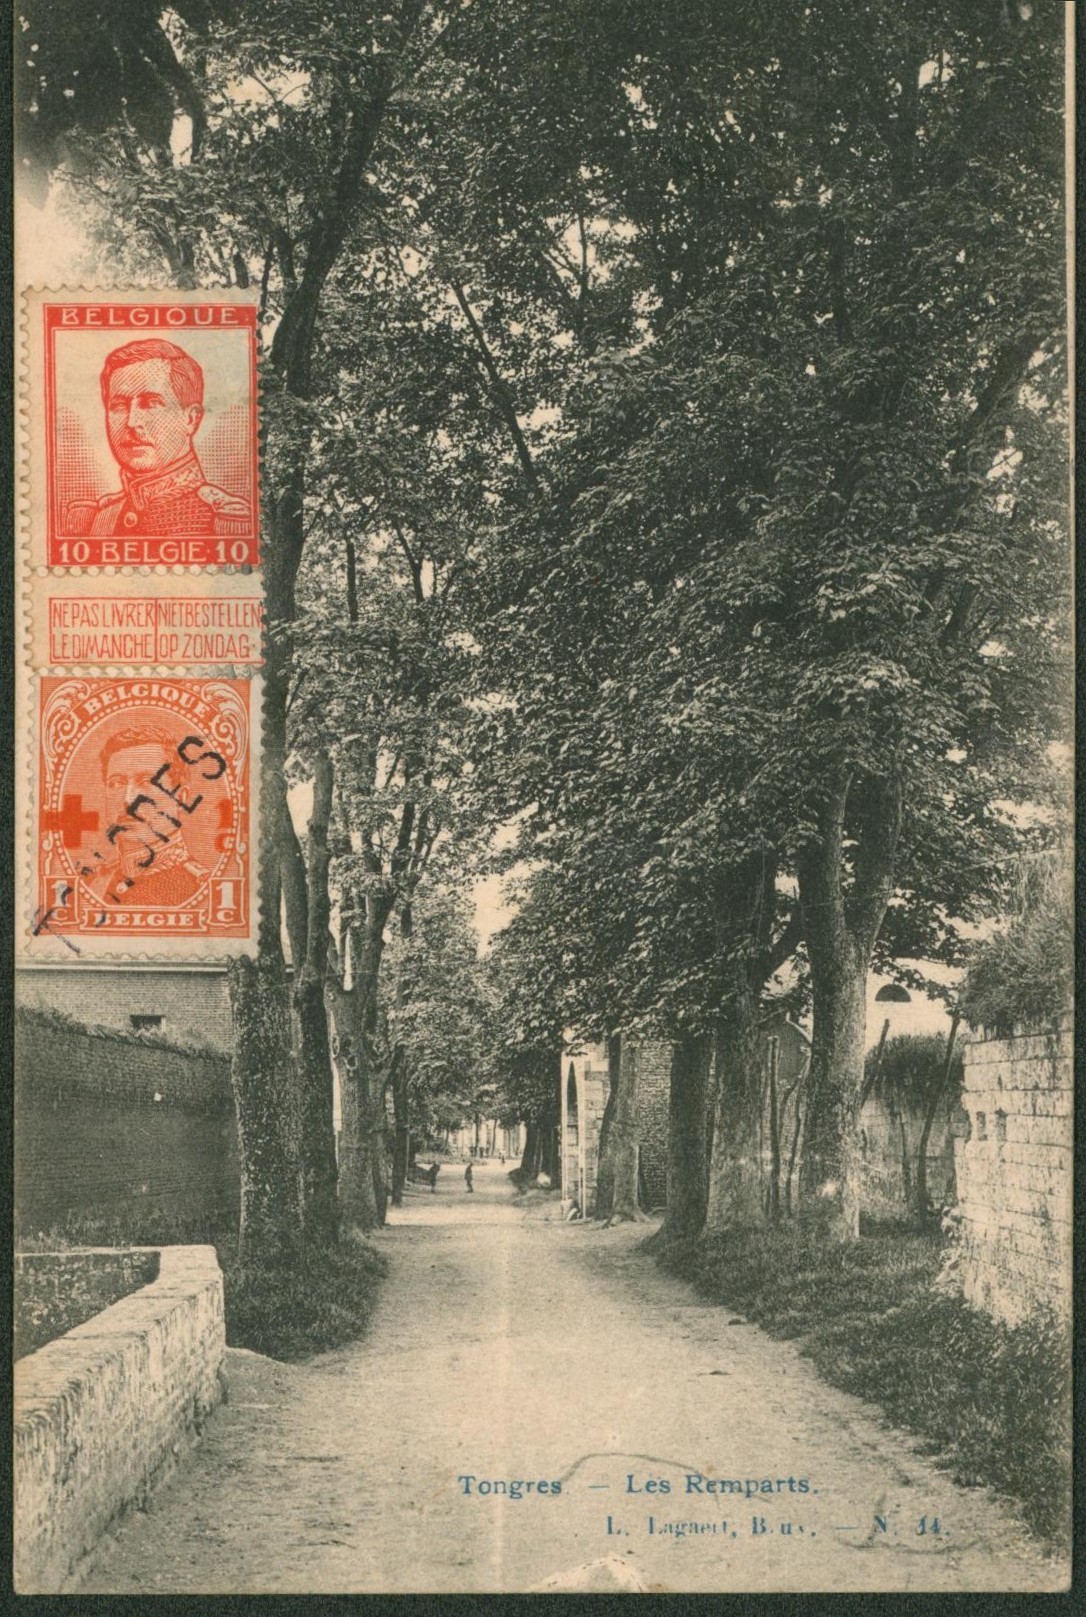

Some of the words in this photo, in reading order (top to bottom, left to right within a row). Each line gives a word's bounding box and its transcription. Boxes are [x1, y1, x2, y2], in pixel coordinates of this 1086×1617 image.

[58, 540, 91, 563] 10
[101, 540, 207, 563] BELGIE
[215, 540, 250, 563] 10
[71, 602, 100, 628] PAS
[102, 602, 155, 628] LIVRER
[72, 633, 154, 660] DIMANCHE
[159, 632, 179, 659] OP
[181, 632, 250, 659] ZONDAG
[82, 683, 211, 717] BELGIQUE
[215, 881, 238, 909] 1
